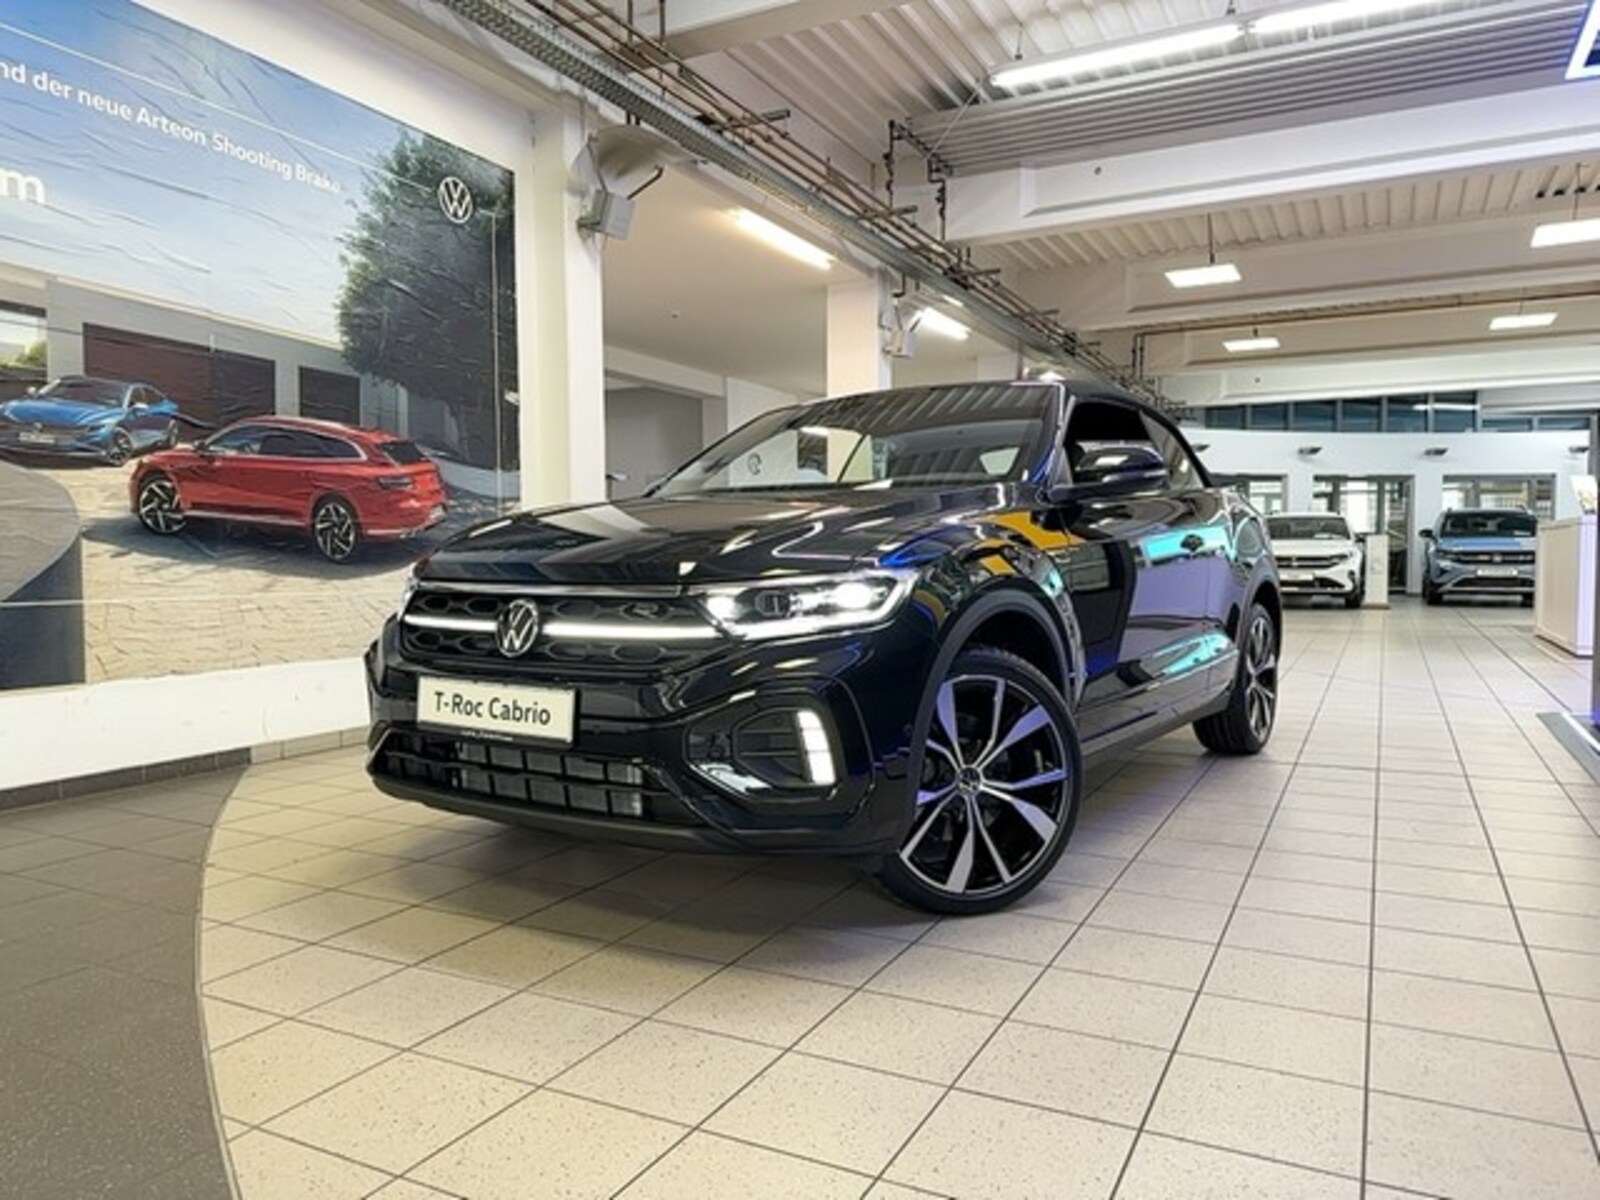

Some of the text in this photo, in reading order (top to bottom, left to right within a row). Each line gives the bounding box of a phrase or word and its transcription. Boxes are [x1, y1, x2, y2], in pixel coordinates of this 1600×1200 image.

[33, 71, 73, 99] der
[78, 88, 132, 120] neue
[136, 107, 207, 146] Arteon
[212, 133, 292, 181] Shooting
[437, 176, 473, 224] VW
[496, 599, 538, 657] VW
[434, 691, 551, 726] T-Roc Cabrio
